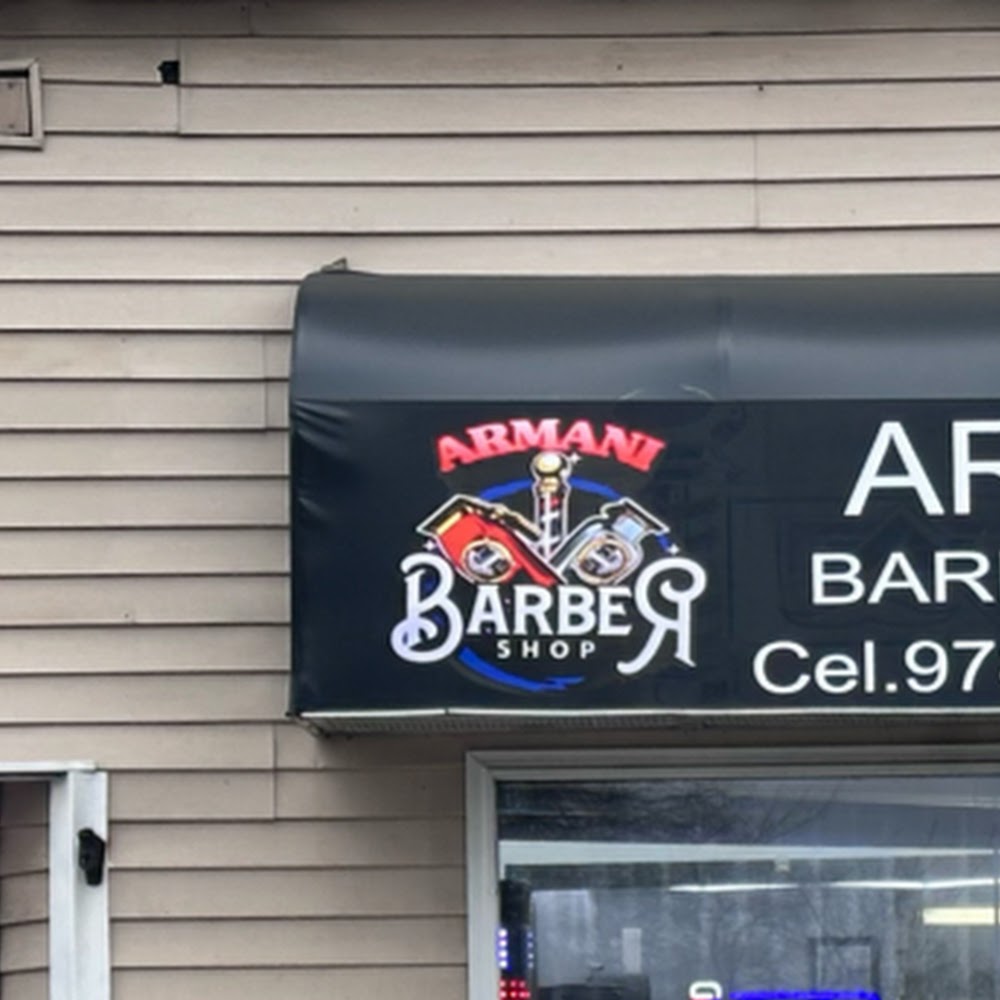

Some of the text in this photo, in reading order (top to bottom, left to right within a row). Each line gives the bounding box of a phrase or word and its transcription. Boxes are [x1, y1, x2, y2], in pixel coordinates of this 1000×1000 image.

[435, 418, 666, 473] ARMANI
[390, 552, 708, 676] BARBER
[497, 640, 598, 660] SHOP
